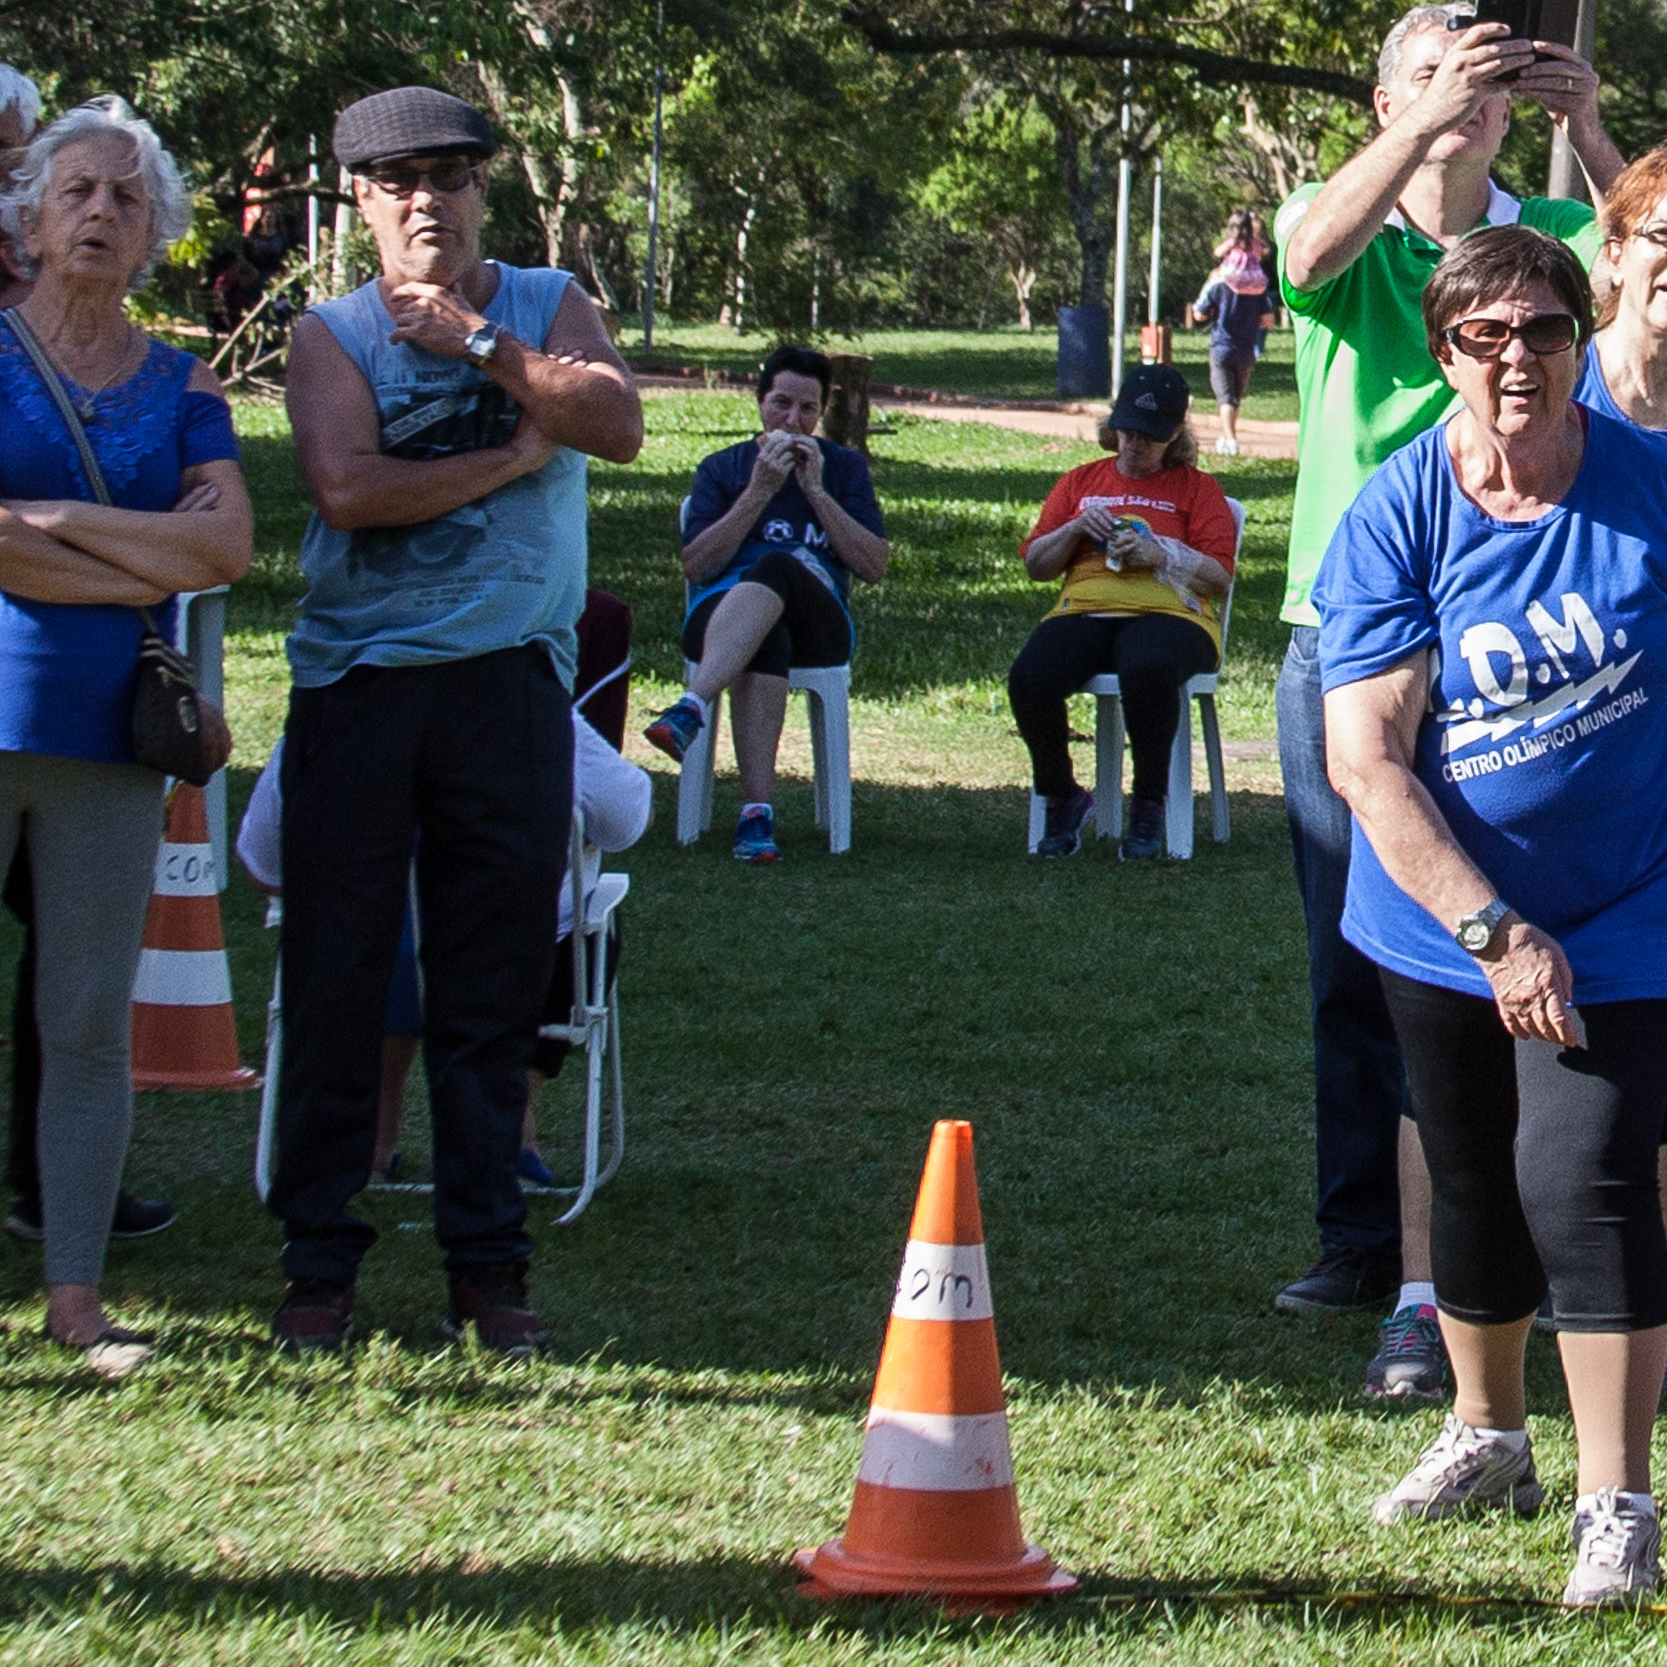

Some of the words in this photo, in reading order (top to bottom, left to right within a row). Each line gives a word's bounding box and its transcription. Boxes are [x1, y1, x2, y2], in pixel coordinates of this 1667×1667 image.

[1442, 750, 1503, 783] CENTRO
[1502, 726, 1577, 767] OLÍMPICO
[1576, 687, 1649, 738] MUNICIPAL
